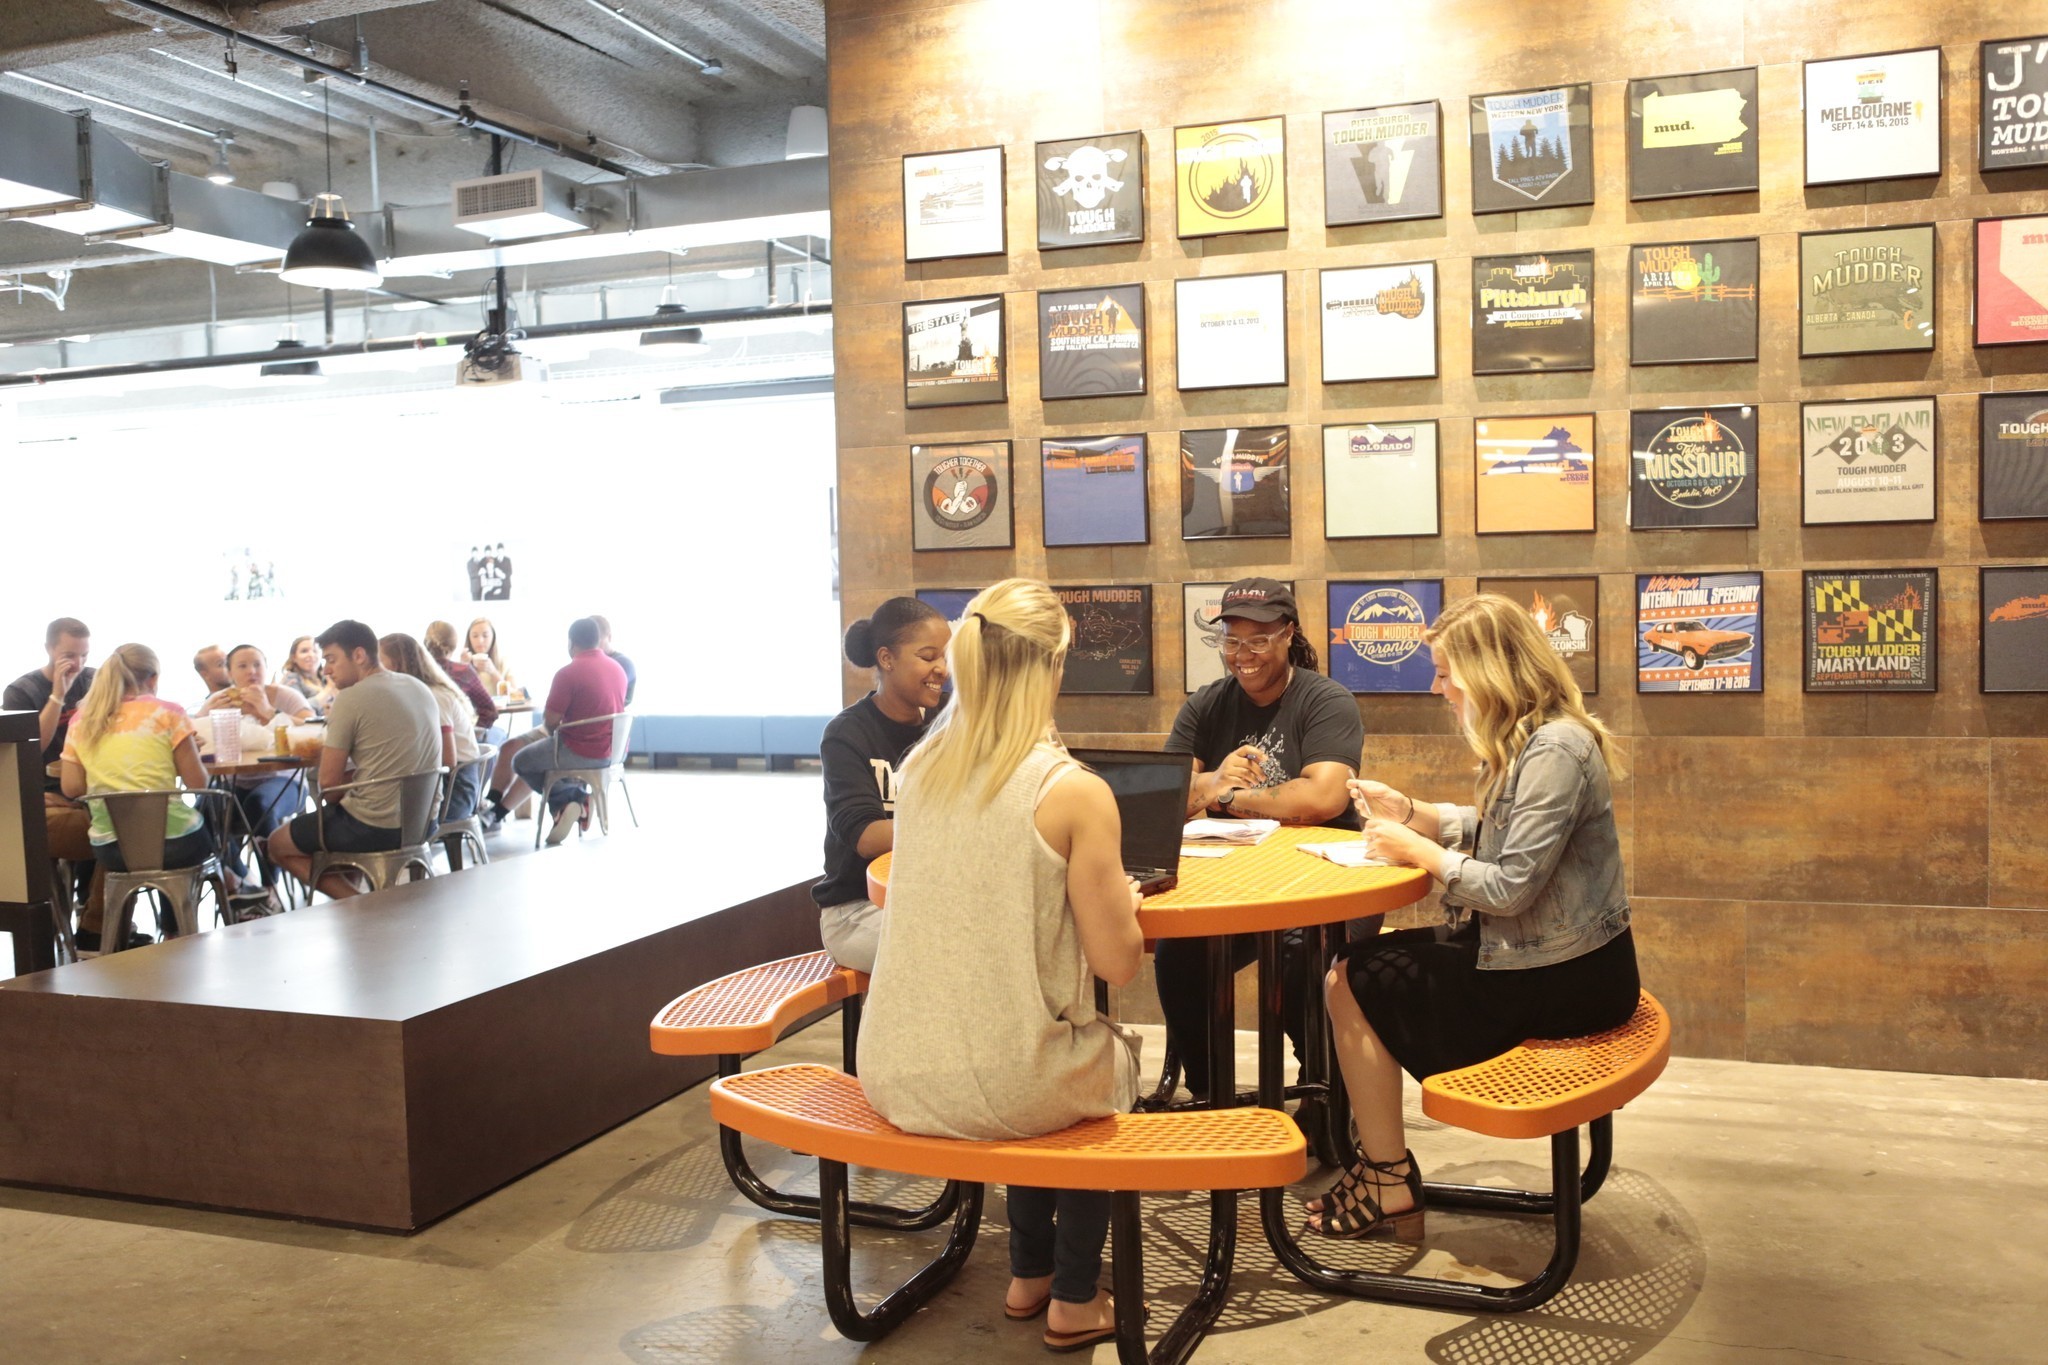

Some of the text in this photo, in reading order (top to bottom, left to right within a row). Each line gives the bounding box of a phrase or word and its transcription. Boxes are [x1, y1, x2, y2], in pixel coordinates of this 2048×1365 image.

[1488, 92, 1564, 111] TOUGH MUDDER
[1491, 111, 1525, 119] WESTERN
[1544, 104, 1564, 112] YORK
[1820, 101, 1912, 123] MELBOURNE
[1351, 114, 1410, 127] PITTSBURGH
[1654, 121, 1695, 133] mud.
[1832, 117, 1909, 131] SEPT. 14 & 15, 2013
[1201, 128, 1219, 142] 2015
[1333, 122, 1428, 144] TOUGH MUDDER
[1067, 208, 1115, 226] TOUGH
[1069, 222, 1115, 234] MUDDER
[1642, 246, 1690, 260] TOUGH
[1834, 246, 1901, 265] TOUGH
[1639, 258, 1696, 273] MUDDER
[1812, 262, 1922, 296] MUDDER
[1378, 287, 1412, 300] TOUGH
[1480, 283, 1587, 309] Pittsburgh
[1379, 299, 1421, 313] MUDDER
[927, 313, 961, 329] STATE
[1049, 310, 1102, 326] TOUGH
[1511, 311, 1545, 321] Coopers
[1548, 309, 1568, 318] Lake
[1806, 310, 1876, 324] ALBERTA CANADA
[1050, 325, 1104, 336] MUDDER
[1050, 334, 1138, 346] SOUTHERN CALIFORNIA
[1806, 410, 1930, 435] NEW ENGLAND
[1669, 426, 1704, 436] TOUGH
[1352, 443, 1411, 451] COLORADO
[1676, 443, 1706, 456] Takes
[1236, 453, 1264, 464] MUDDER
[1645, 451, 1746, 480] MISSOURI
[933, 457, 987, 475] TOUGHER TOGETHER
[1837, 464, 1907, 476] TOUGH MUDDER
[1666, 480, 1692, 488] OCTOBER
[1837, 475, 1902, 488] AUGUST 10-11
[1646, 575, 1699, 594] Michigan
[1056, 589, 1142, 604] OUGH MUDDER
[1641, 585, 1760, 609] INTERNATIONAL SPEEDWAY
[1350, 625, 1419, 639] TOUGH MUDDER
[1357, 639, 1416, 657] Toronto
[1549, 640, 1586, 650] SCONSIN
[1818, 644, 1920, 658] TOUGH MUDDER
[1817, 656, 1910, 673] MARYLAND
[1910, 656, 1921, 678] 2012
[1816, 672, 1857, 680] SEPTEMBER
[1679, 678, 1714, 691] SEPTEMBER
